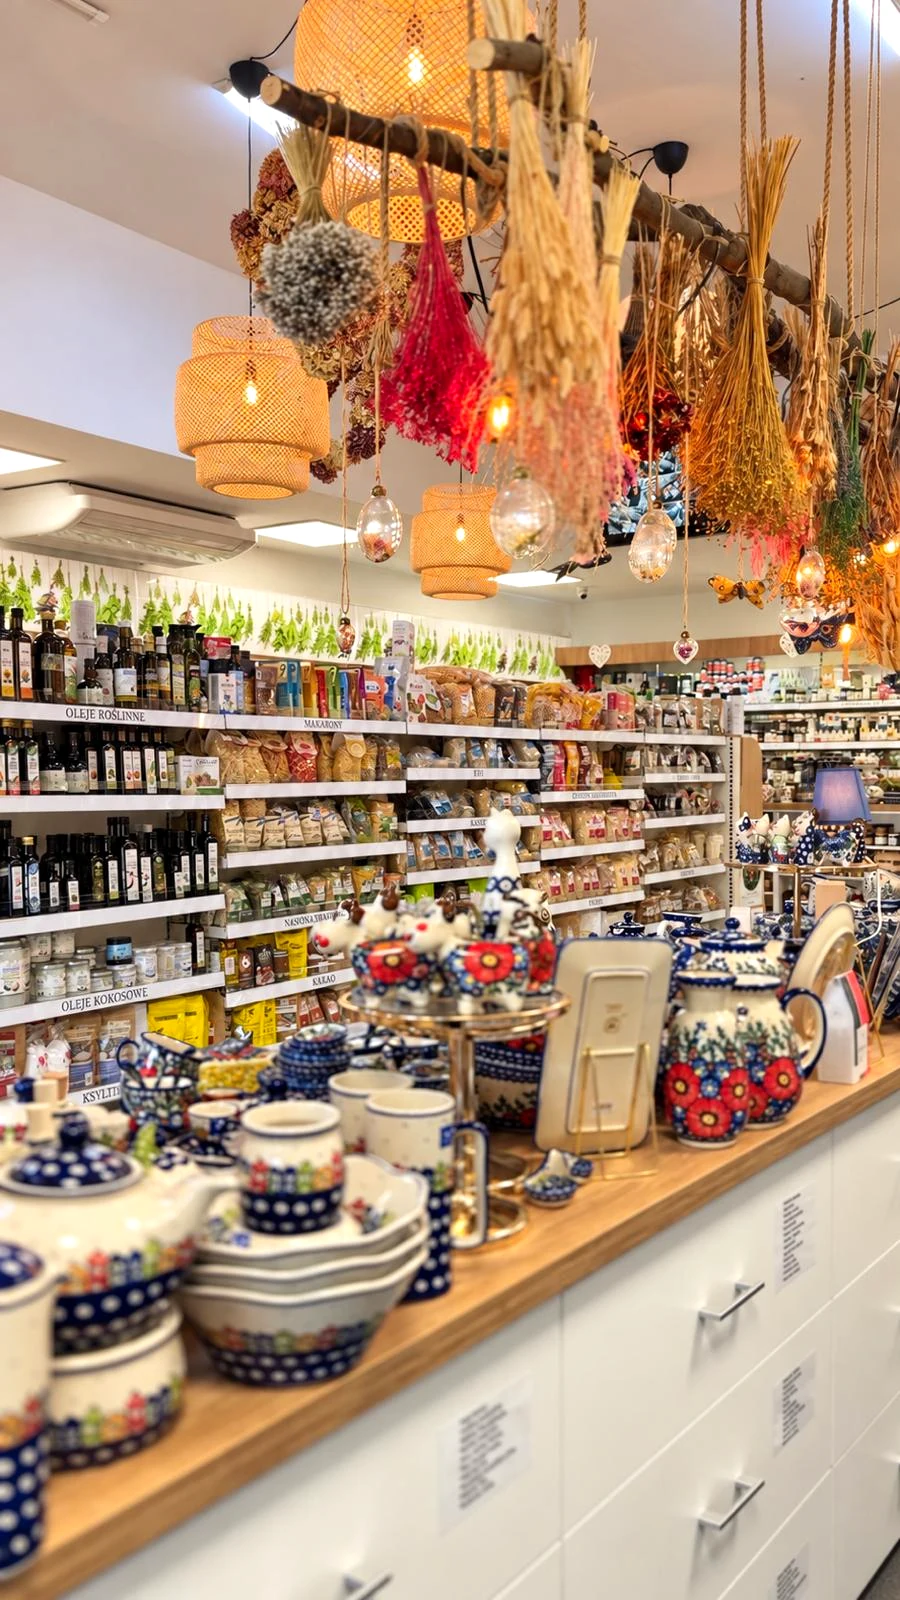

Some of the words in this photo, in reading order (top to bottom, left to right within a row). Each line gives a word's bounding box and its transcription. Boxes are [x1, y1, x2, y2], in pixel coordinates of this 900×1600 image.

[65, 707, 96, 720] OLEJE
[98, 708, 145, 722] ROŚLINNE
[61, 997, 91, 1012] OLEJE
[94, 987, 148, 1007] KOKOSOWE
